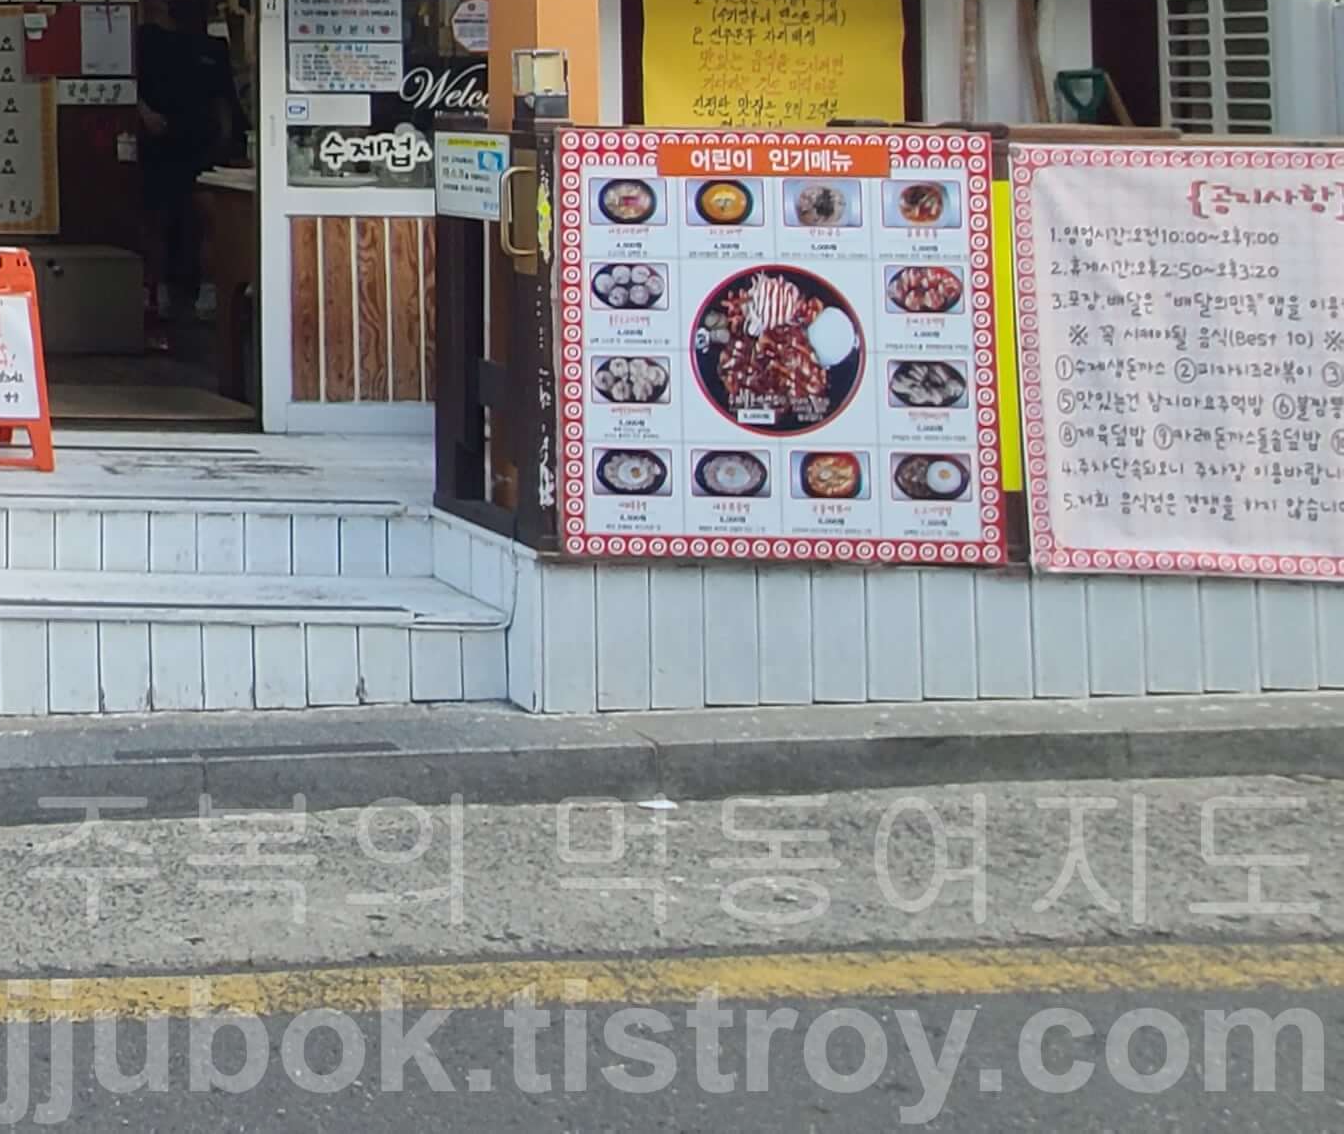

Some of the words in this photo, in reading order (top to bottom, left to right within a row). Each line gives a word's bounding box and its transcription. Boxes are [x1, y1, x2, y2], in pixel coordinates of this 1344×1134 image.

[689, 148, 753, 174] 어린이
[767, 149, 855, 173] 인기메뉴
[1195, 461, 1245, 483] 주차장
